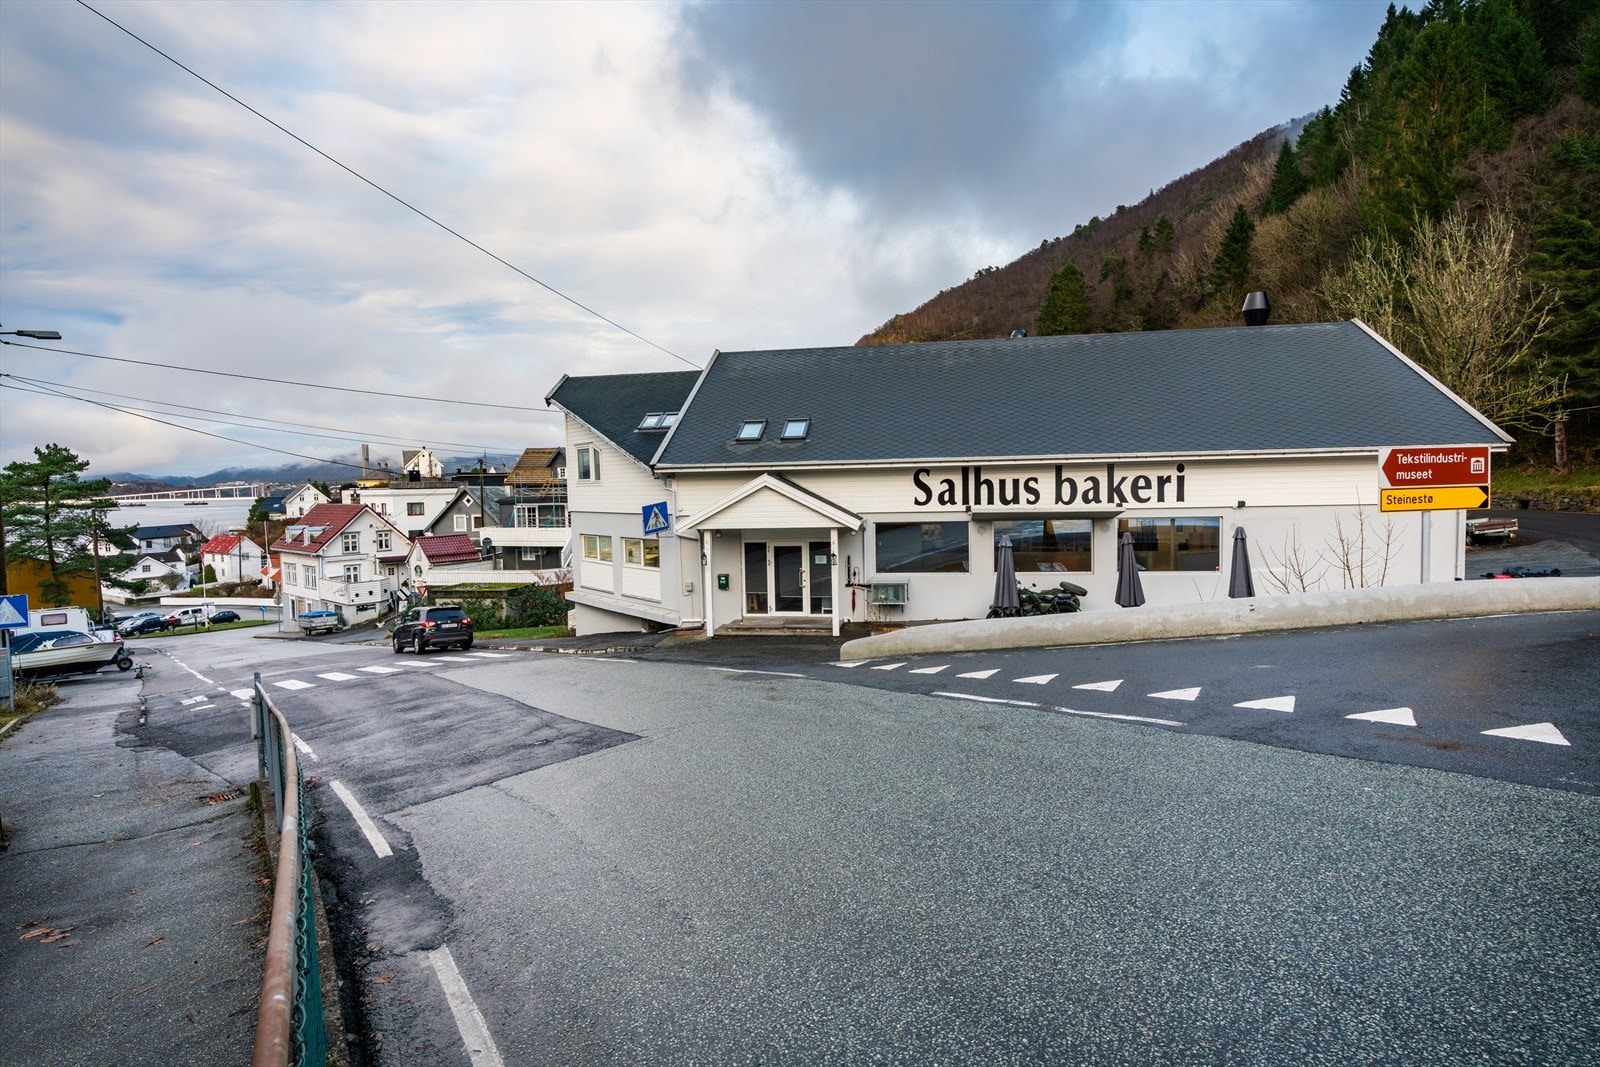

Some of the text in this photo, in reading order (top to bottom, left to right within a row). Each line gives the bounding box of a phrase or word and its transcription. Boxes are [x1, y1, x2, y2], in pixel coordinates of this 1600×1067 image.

[1396, 452, 1468, 464] Tekstilindustri-
[1396, 469, 1433, 480] museet
[913, 463, 1186, 506] Salhus bakeri
[1386, 494, 1434, 505] Steinestø
